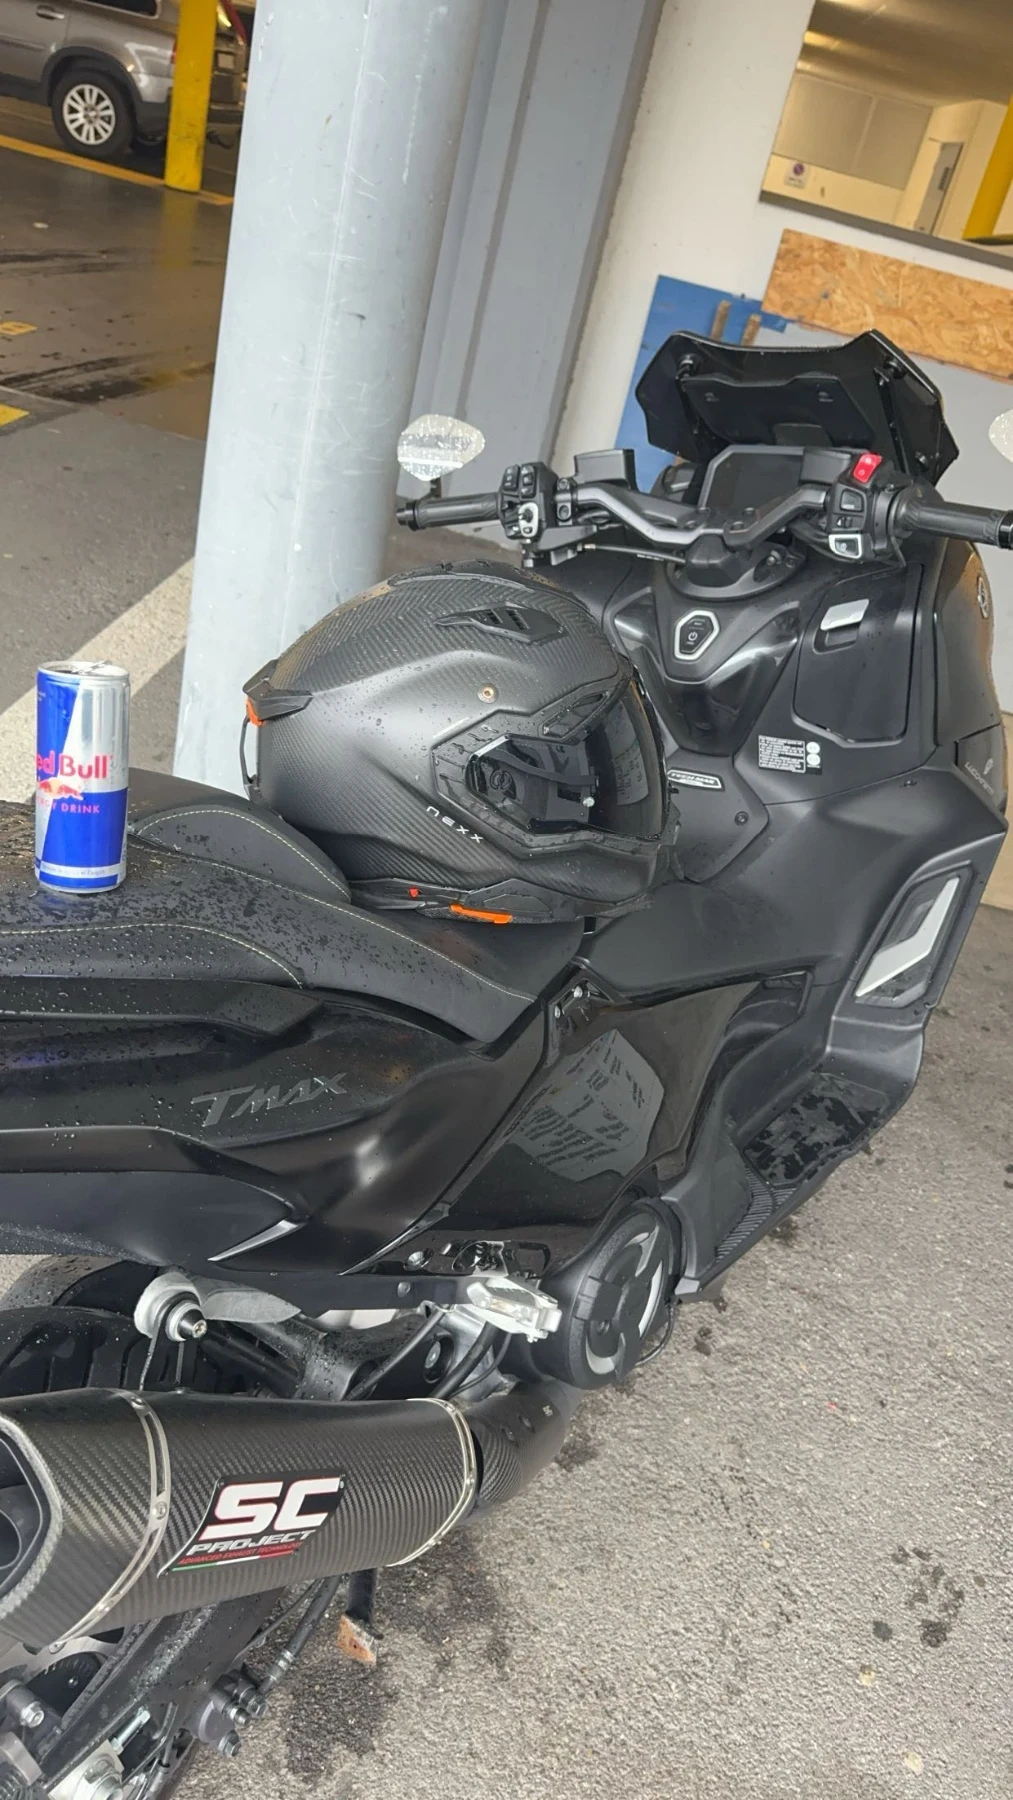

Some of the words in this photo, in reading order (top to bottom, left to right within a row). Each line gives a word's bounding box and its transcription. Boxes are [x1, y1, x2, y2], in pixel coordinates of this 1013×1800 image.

[59, 753, 108, 779] Bull
[61, 802, 100, 814] DRINK
[190, 1072, 348, 1127] TMAX
[198, 1477, 341, 1541] SC
[186, 1529, 316, 1556] PROJECT
[178, 1553, 223, 1565] ADVANCED
[223, 1548, 258, 1560] EXHAUST
